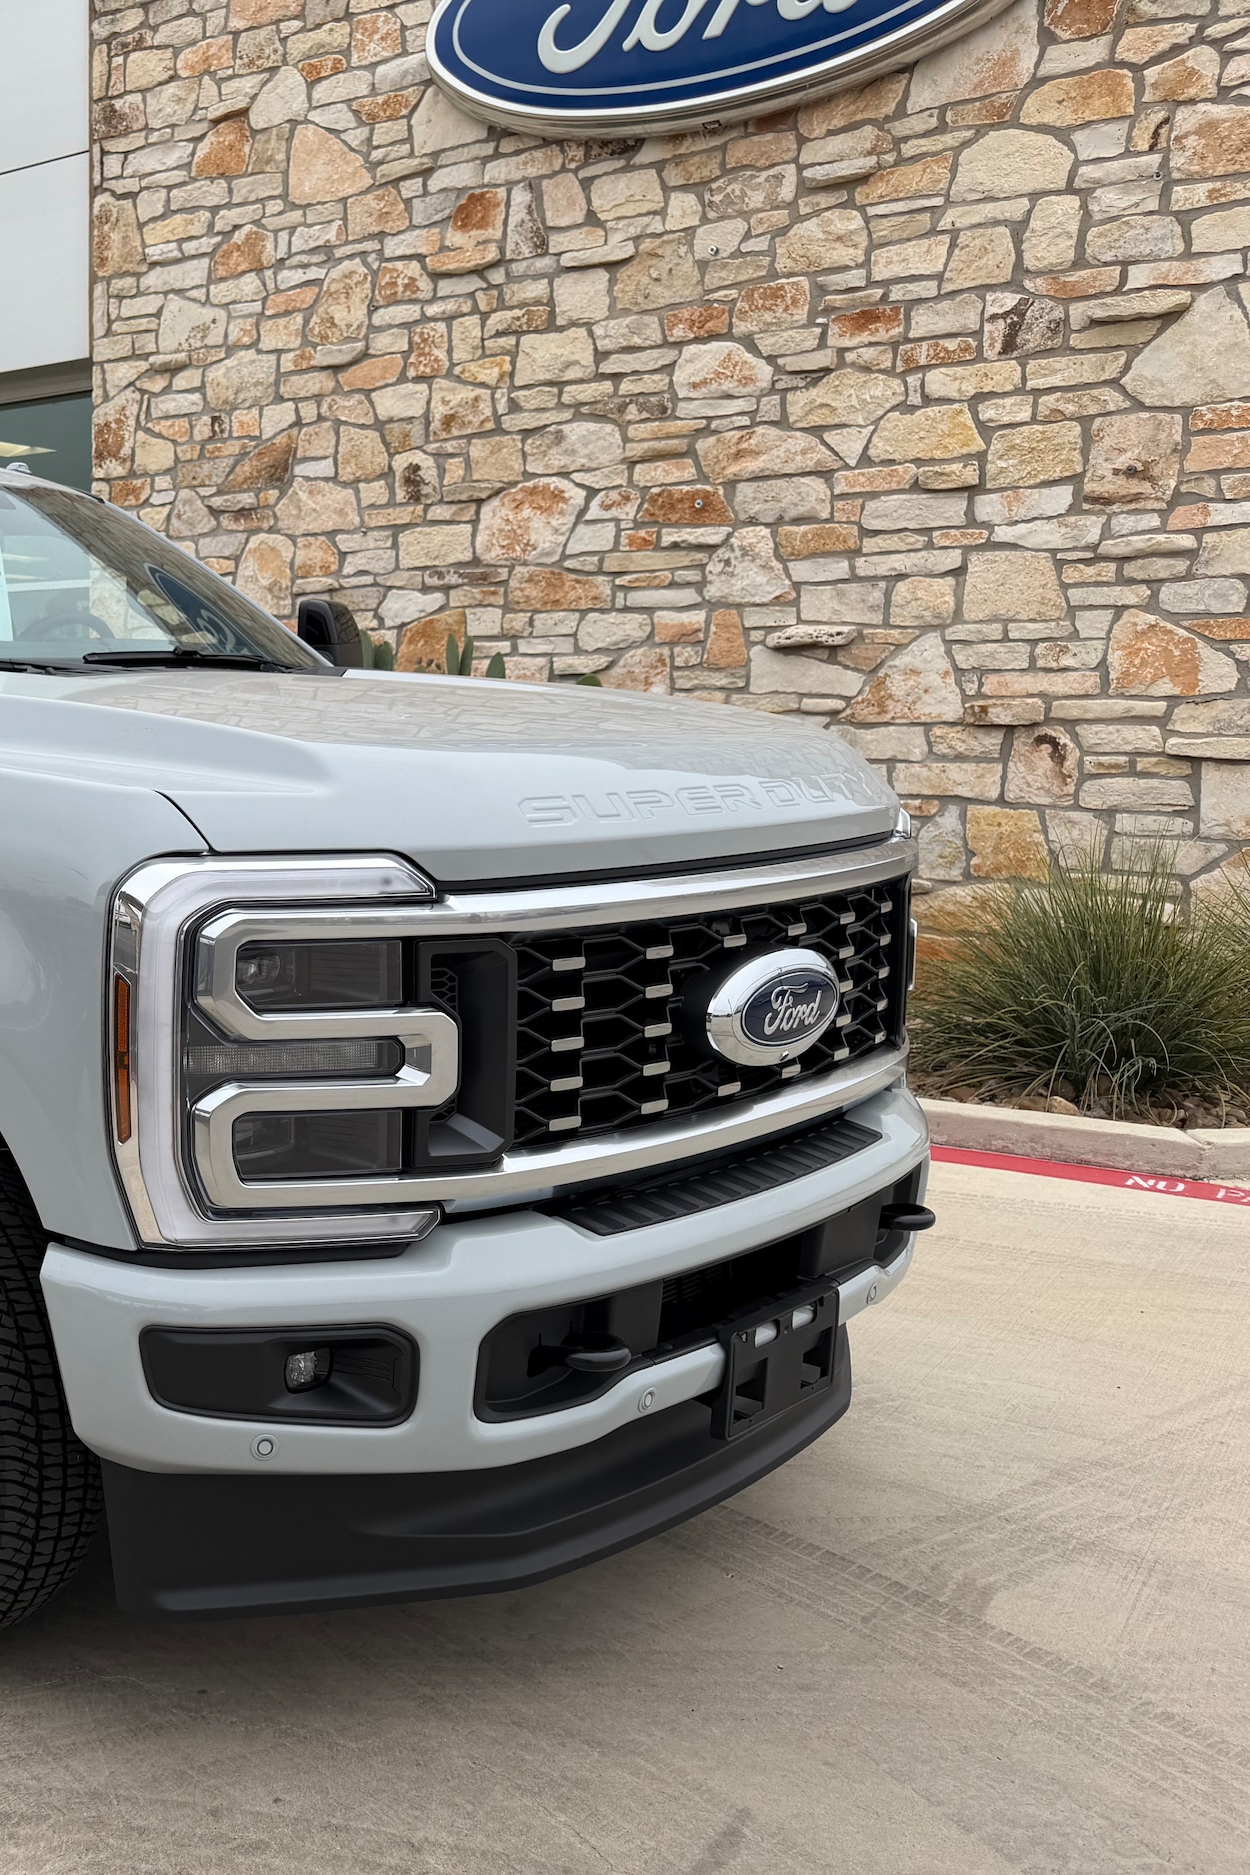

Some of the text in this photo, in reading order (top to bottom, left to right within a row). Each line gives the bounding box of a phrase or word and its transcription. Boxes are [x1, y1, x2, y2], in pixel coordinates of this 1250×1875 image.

[518, 770, 873, 828] SUPER DUTY
[763, 982, 822, 1036] Ford
[1124, 1176, 1185, 1192] NO
